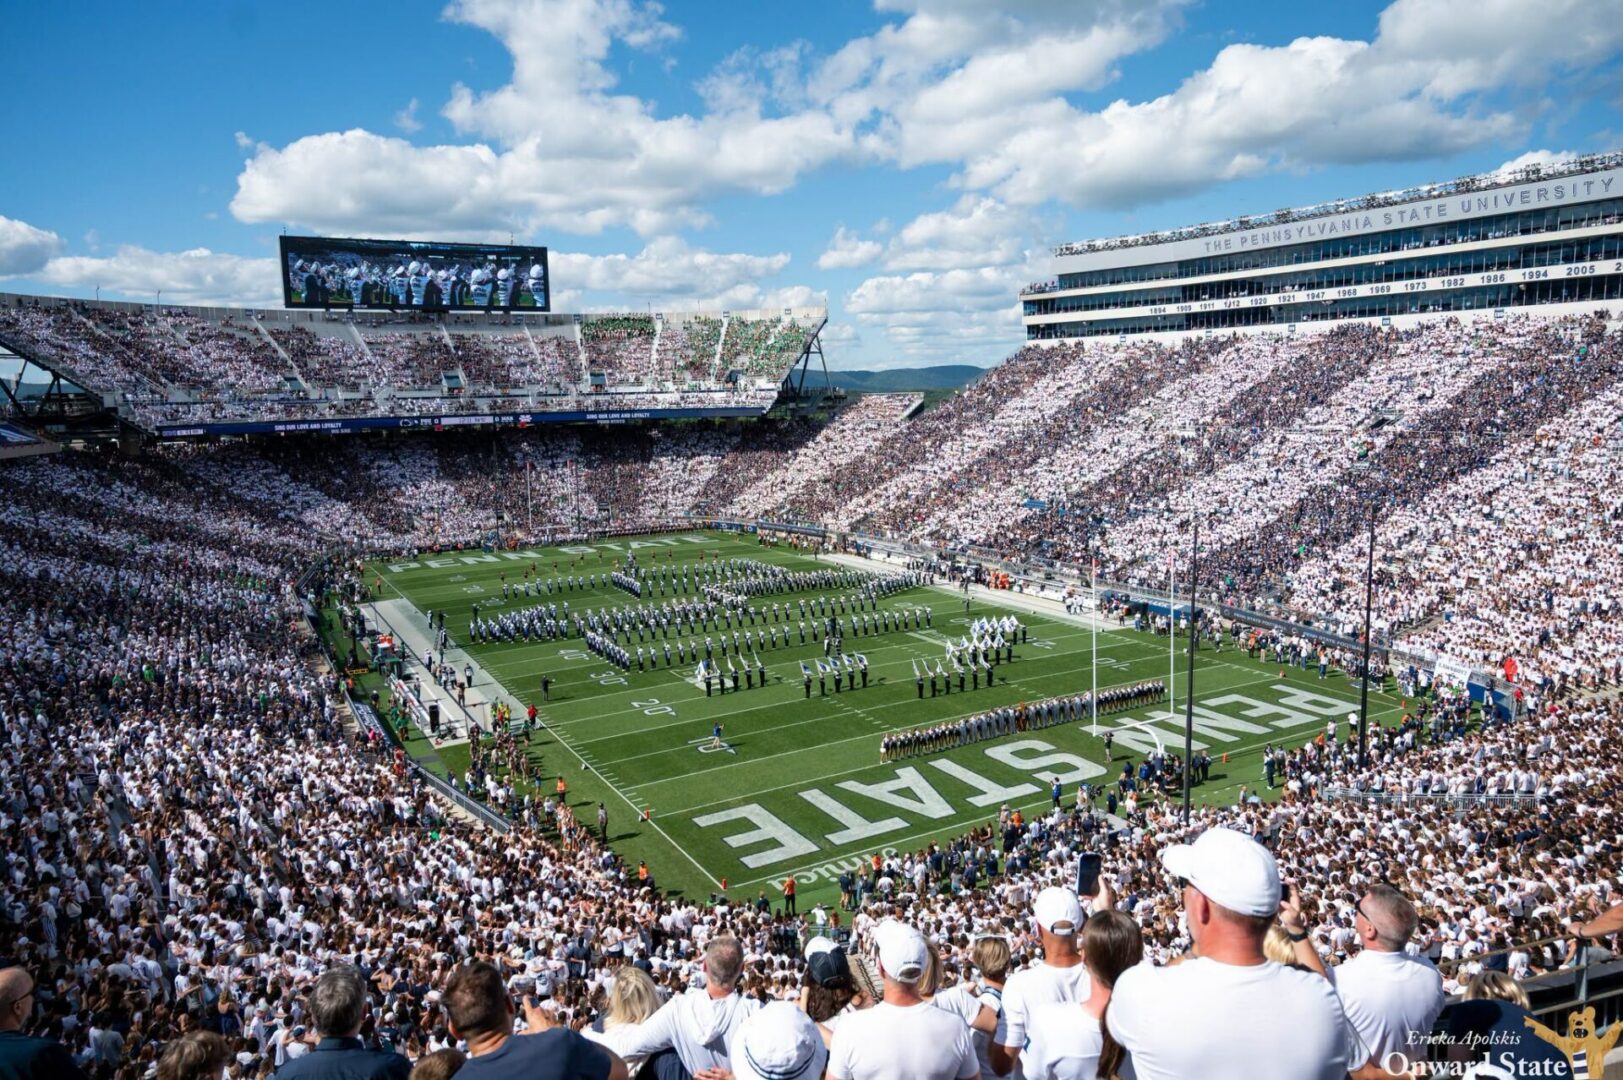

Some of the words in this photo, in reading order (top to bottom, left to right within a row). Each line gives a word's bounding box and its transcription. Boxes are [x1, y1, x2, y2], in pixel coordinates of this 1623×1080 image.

[1204, 238, 1232, 252] THE
[1240, 213, 1373, 248] PENNSYLVANIA
[1383, 203, 1447, 226] STATE
[1460, 177, 1614, 214] UNIVERSITY
[1150, 306, 1167, 315] 1894
[1200, 302, 1215, 311] 1911
[1250, 297, 1267, 306] 1920
[1278, 294, 1296, 303] 1921
[1306, 291, 1326, 301] 1947
[1337, 288, 1357, 298] 1968
[1369, 284, 1391, 294] 1969
[1404, 281, 1427, 291] 1973
[1440, 277, 1465, 288] 1982
[1480, 273, 1506, 284] 1986
[1521, 269, 1549, 281] 1994
[1566, 264, 1596, 276] 2005
[387, 550, 546, 573] PENN
[557, 535, 720, 555] STATE
[590, 670, 626, 685] 30
[630, 698, 673, 716] 20
[1078, 683, 1362, 756] PENN
[691, 738, 1109, 870] STATE
